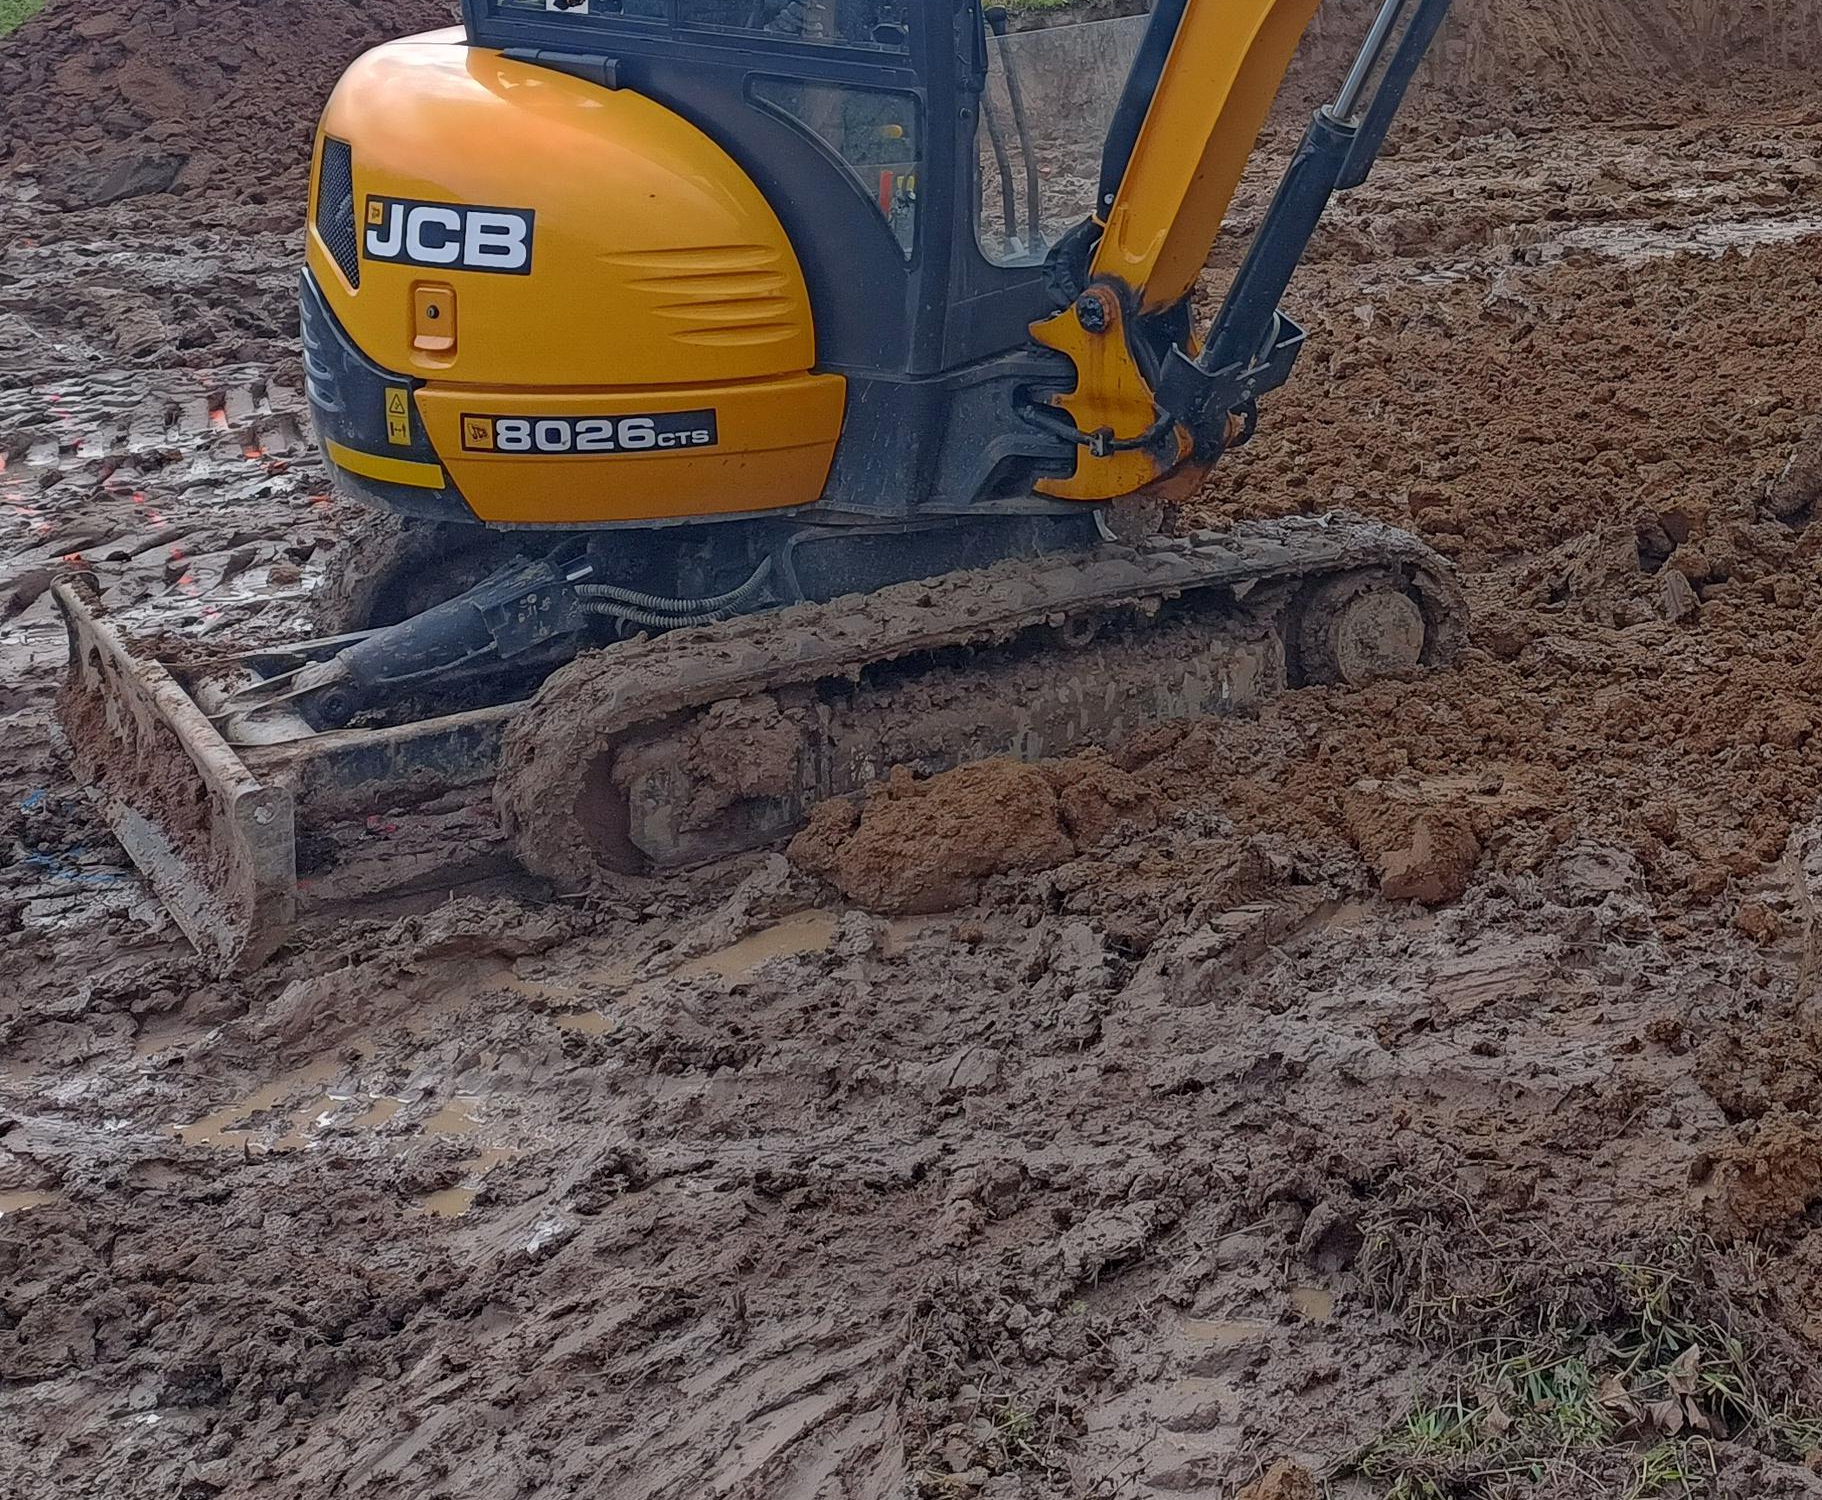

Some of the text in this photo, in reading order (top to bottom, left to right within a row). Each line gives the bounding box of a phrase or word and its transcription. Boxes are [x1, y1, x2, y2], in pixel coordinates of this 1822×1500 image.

[366, 204, 527, 268] JCB
[496, 418, 710, 451] 8026 CTS
